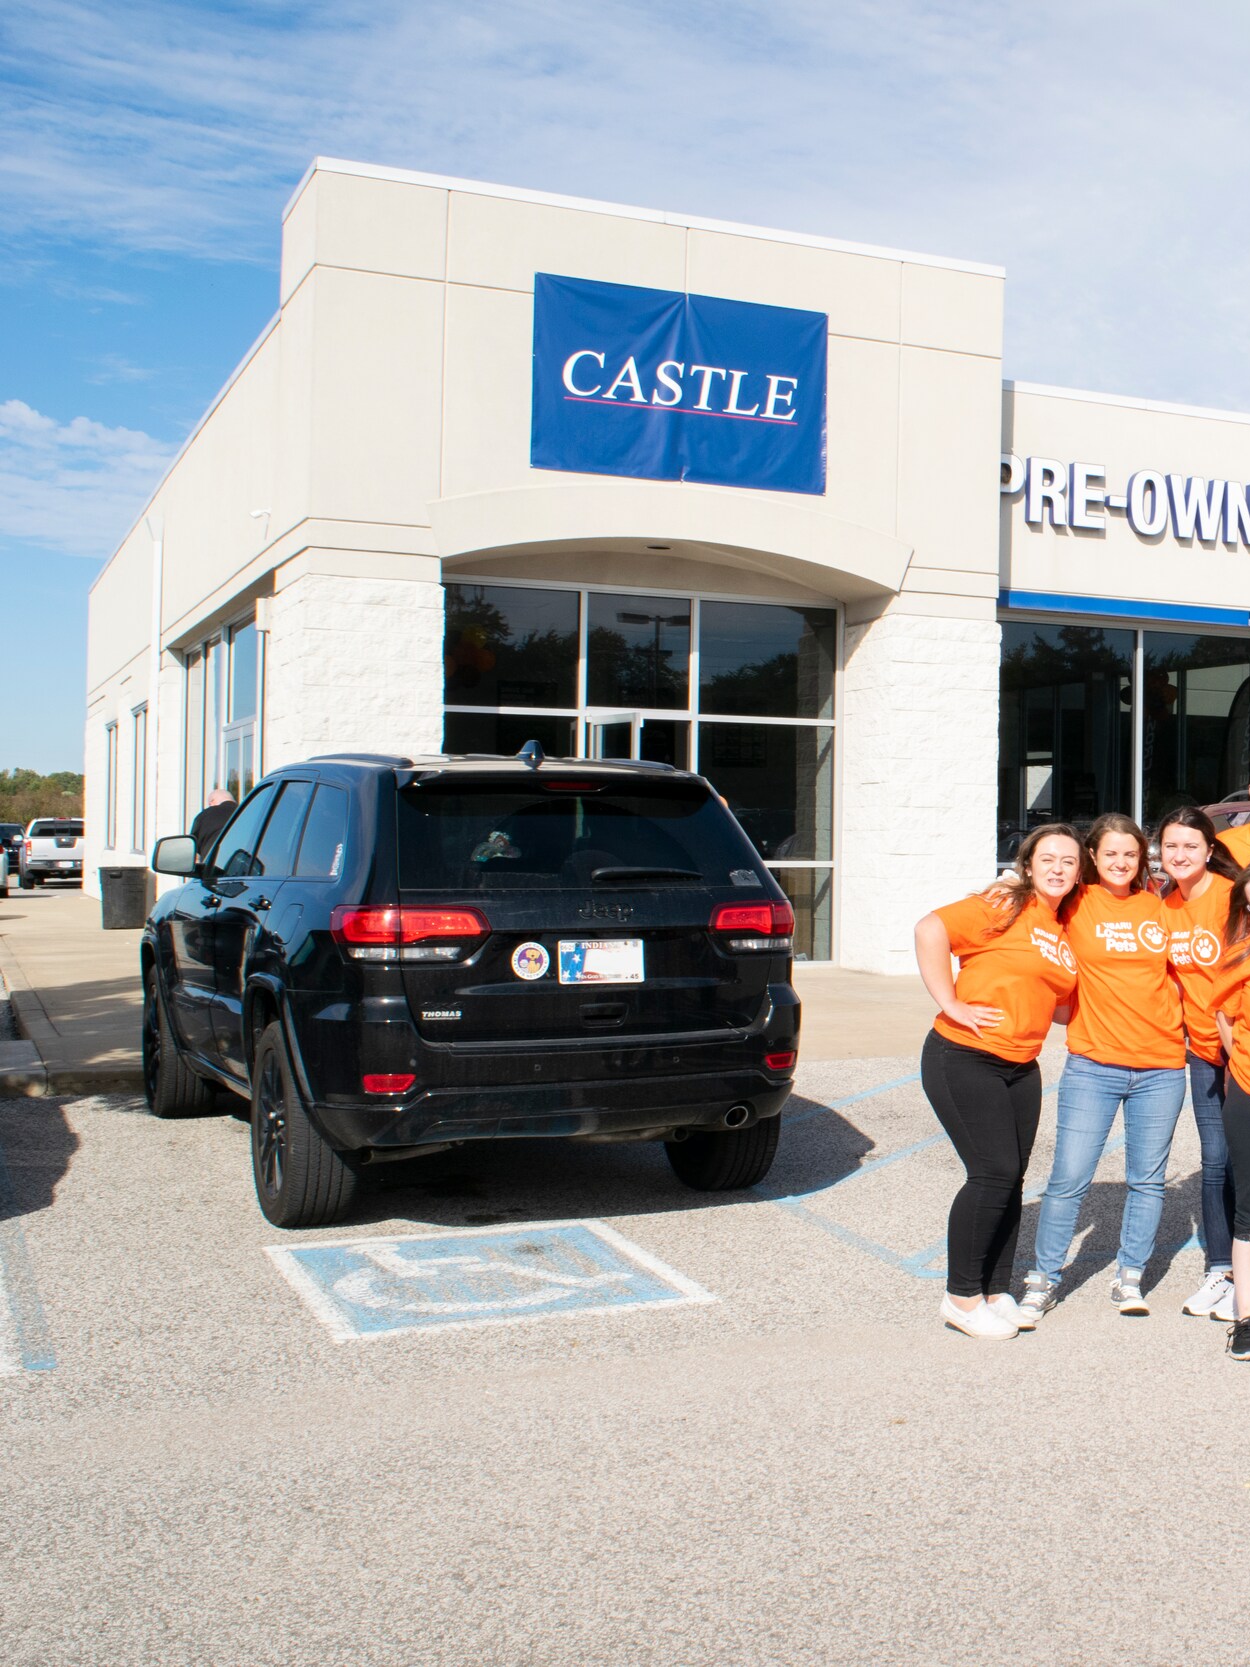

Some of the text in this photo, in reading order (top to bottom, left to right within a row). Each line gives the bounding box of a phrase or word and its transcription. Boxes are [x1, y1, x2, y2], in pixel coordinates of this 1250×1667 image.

[562, 349, 799, 421] CASTLE
[1095, 924, 1136, 940] Loves
[1105, 937, 1138, 952] Pets
[1170, 942, 1190, 953] oves
[1172, 953, 1193, 966] Pets
